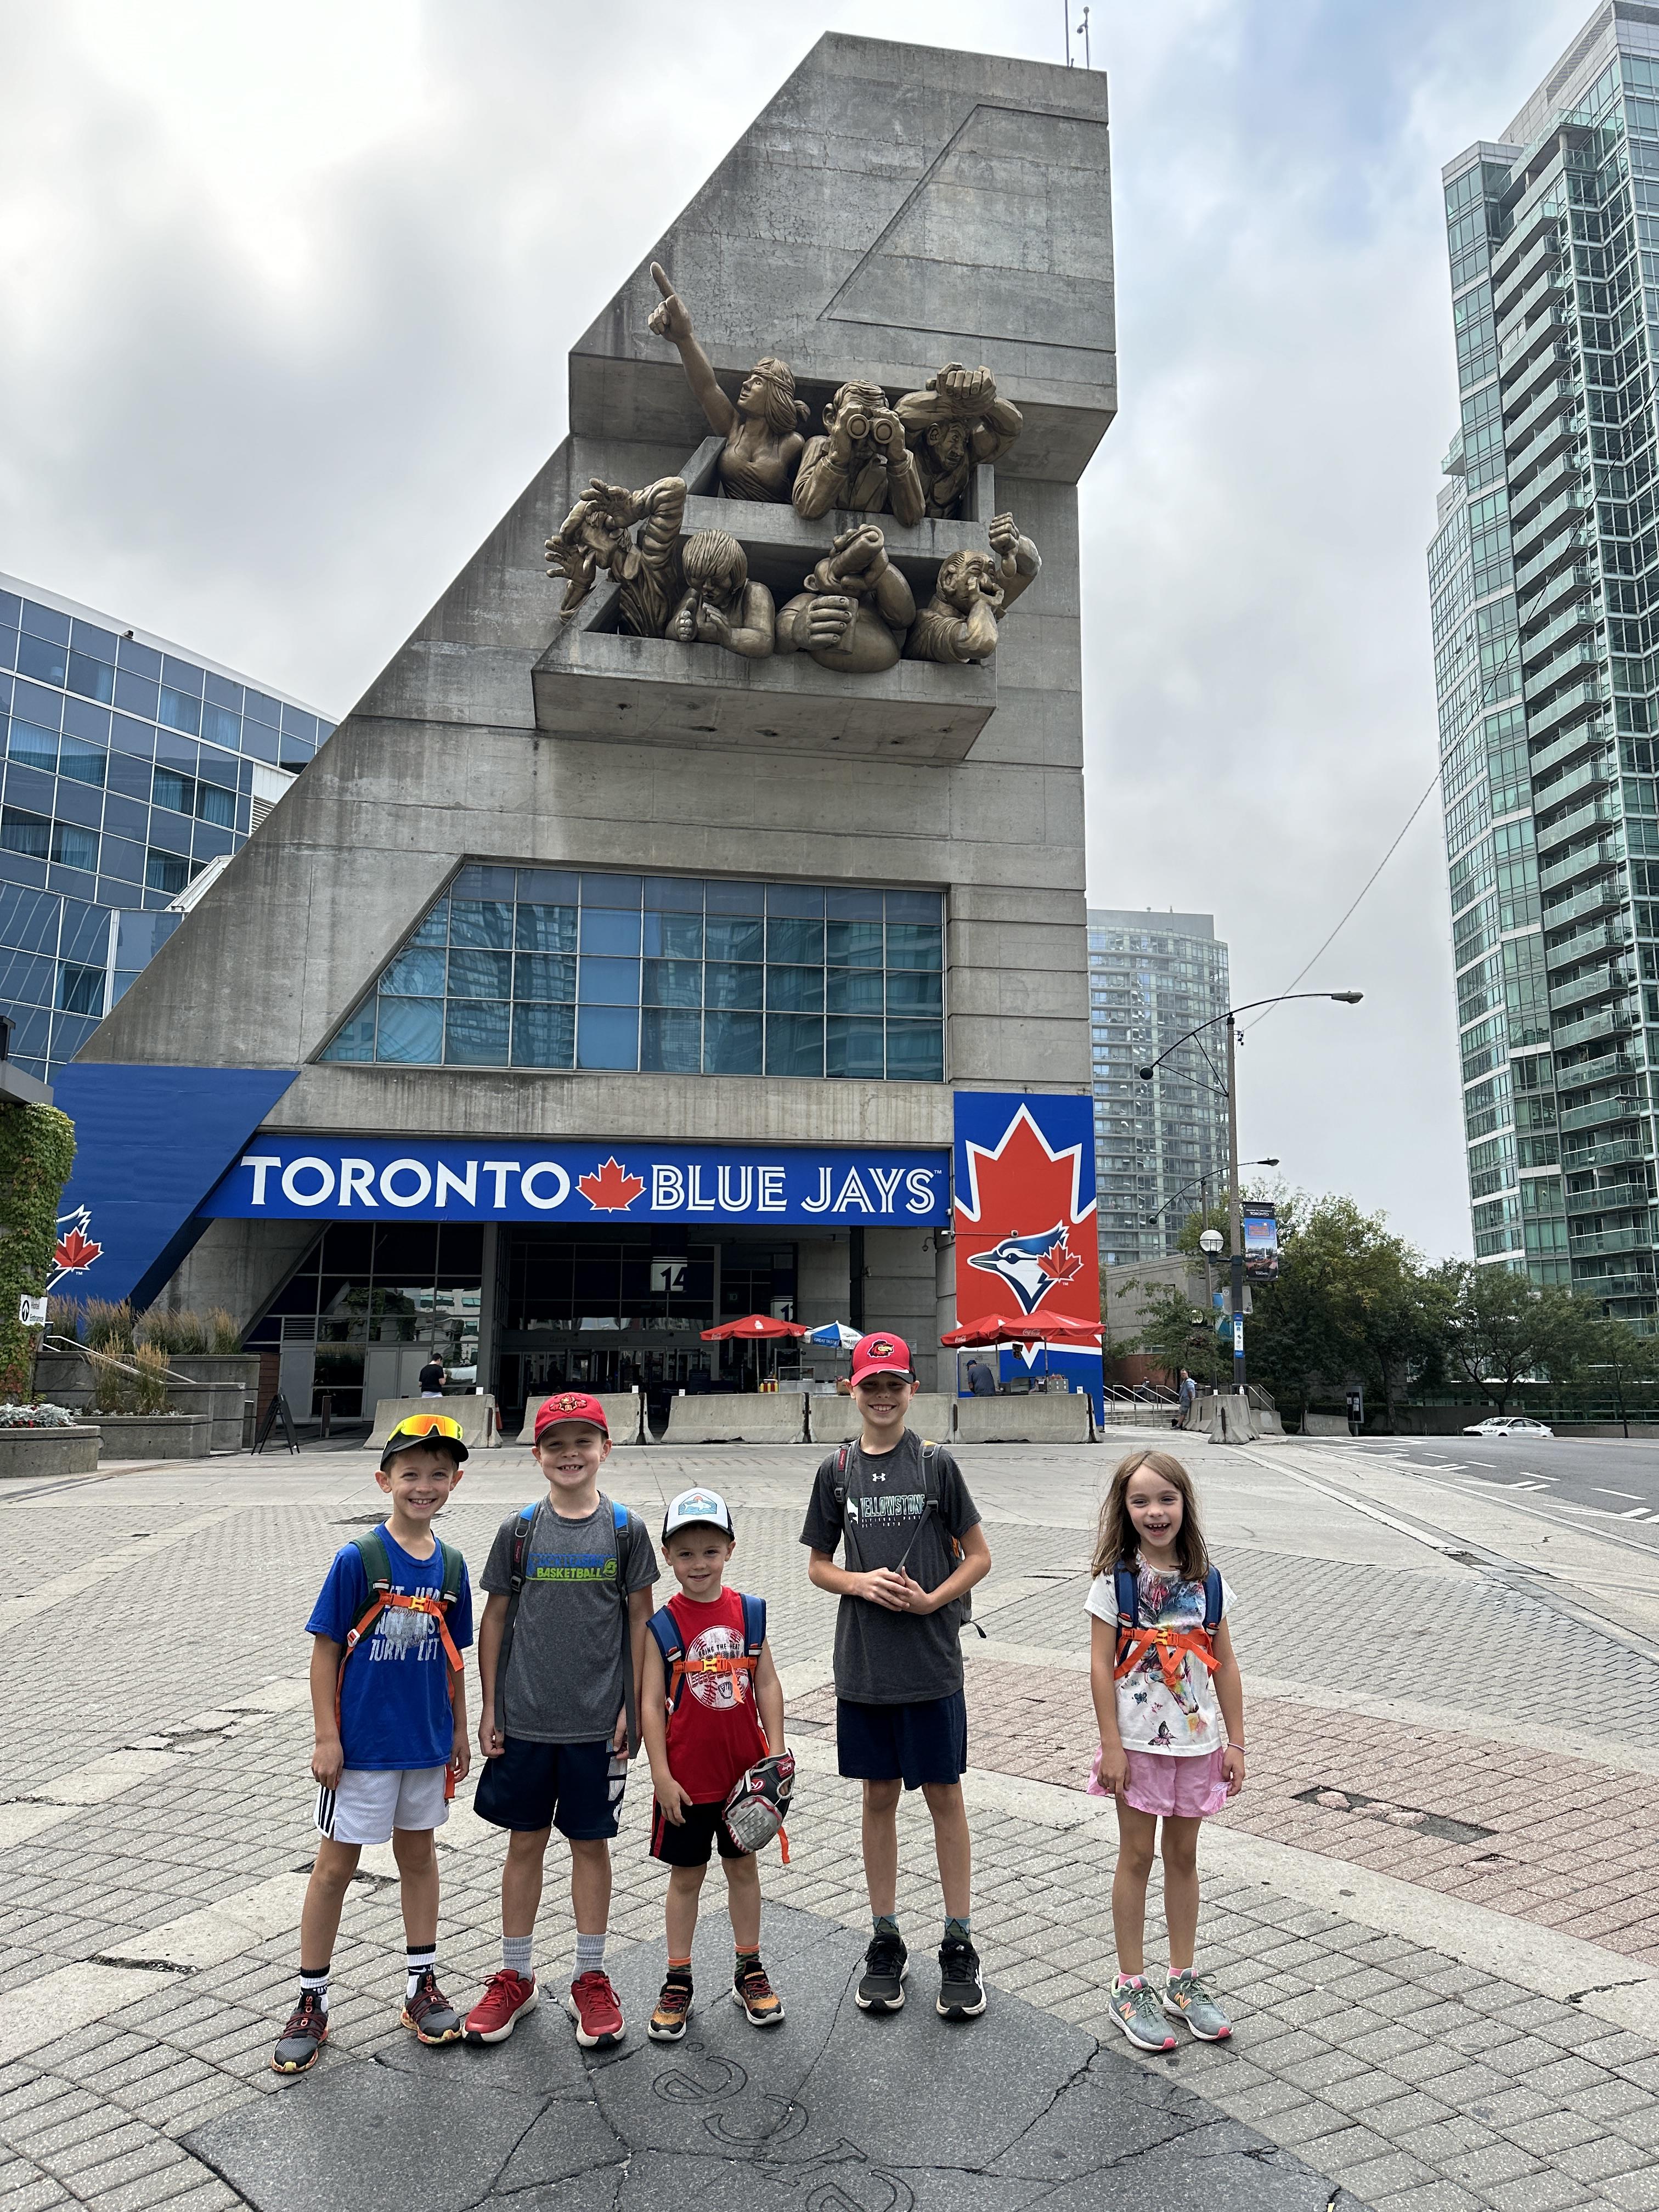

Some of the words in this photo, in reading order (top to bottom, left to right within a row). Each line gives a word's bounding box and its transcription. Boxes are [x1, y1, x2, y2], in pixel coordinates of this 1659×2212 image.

[240, 1156, 570, 1209] TORONTO
[650, 1164, 788, 1212] BLUE
[800, 1166, 935, 1214] JAYS
[660, 1266, 687, 1291] 14
[860, 1494, 925, 1517] YELLOWSTONE
[537, 1567, 602, 1578] BASKETBALL
[369, 1639, 407, 1662] TURN
[698, 1646, 714, 1657] BRING
[716, 1643, 727, 1651] THE
